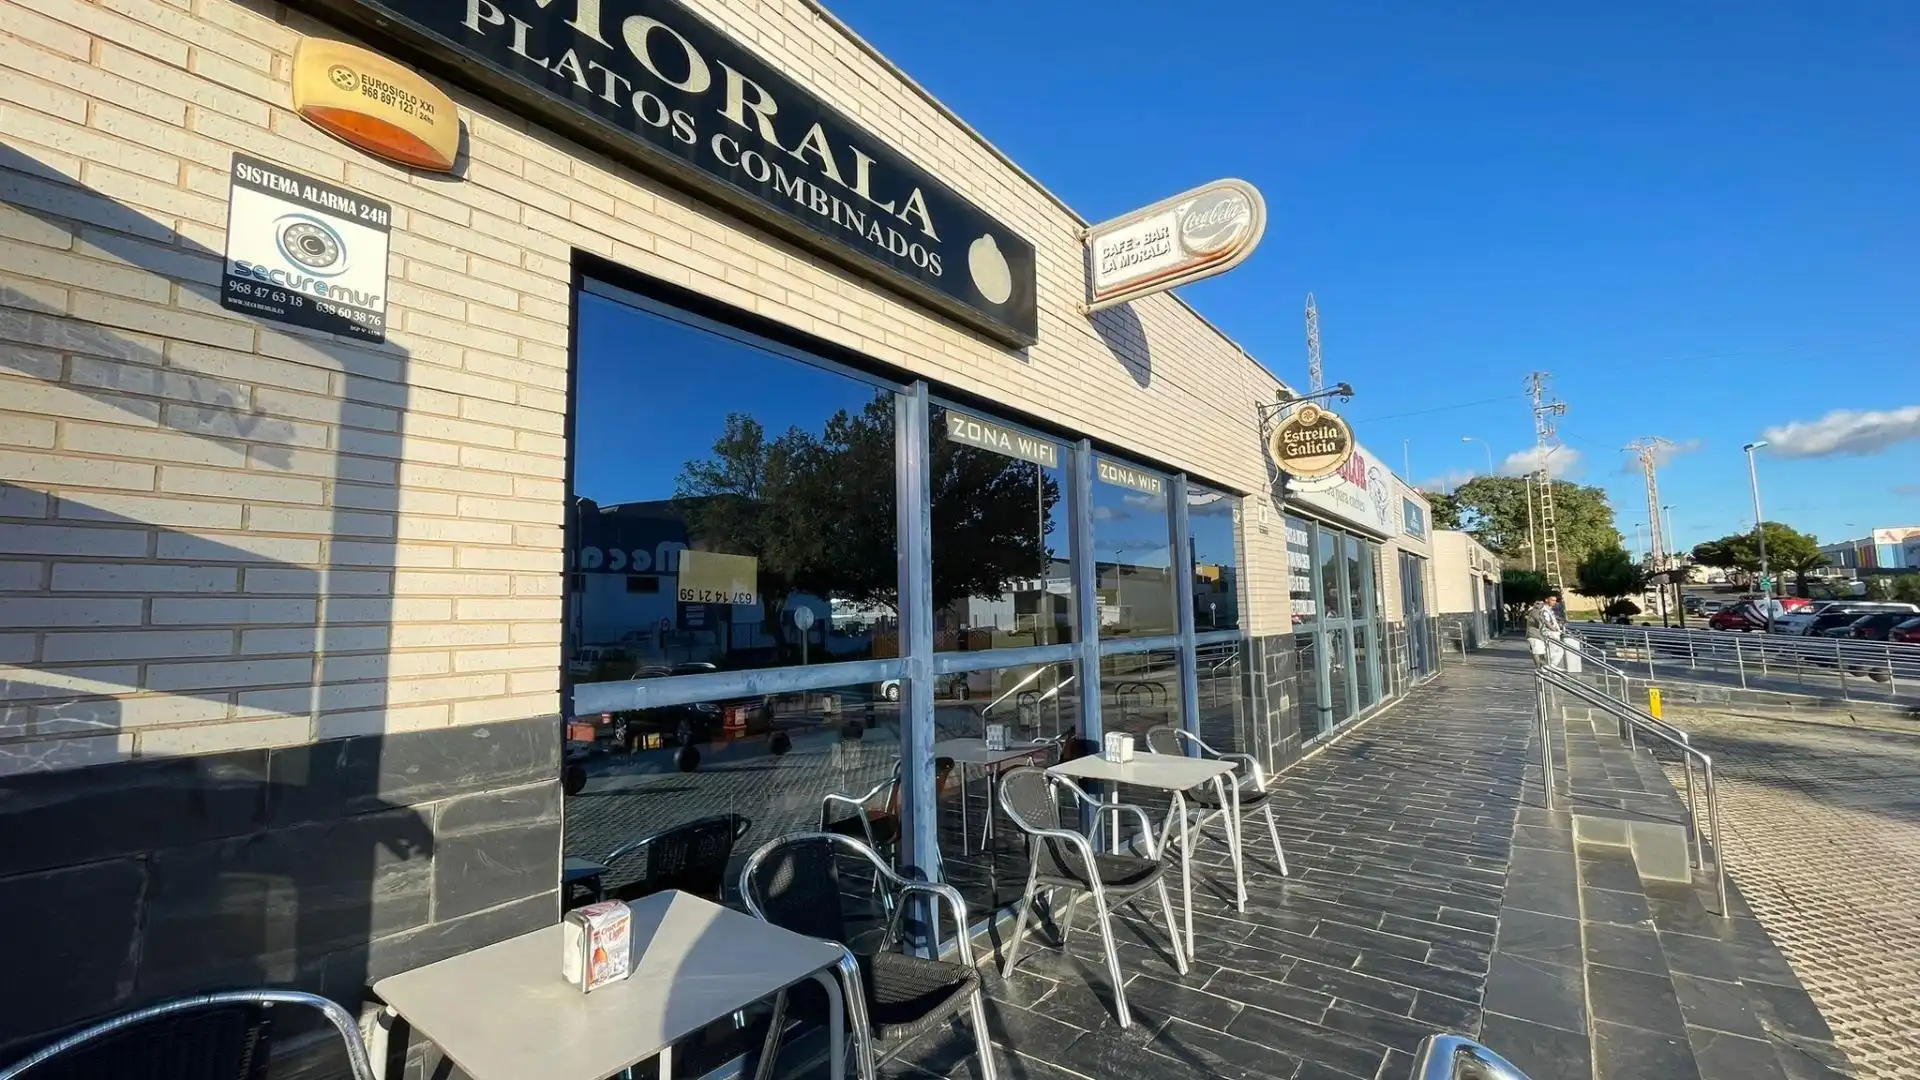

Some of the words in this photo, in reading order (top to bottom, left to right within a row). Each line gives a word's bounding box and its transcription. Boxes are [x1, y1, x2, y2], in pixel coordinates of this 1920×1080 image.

[361, 74, 417, 104] EUROSIGLO
[419, 99, 435, 114] XXI
[361, 84, 379, 100] 968
[380, 91, 397, 107] 897
[398, 99, 414, 115] 123
[460, 0, 698, 145] PLATOS
[710, 132, 944, 277] COMBINADOS
[236, 162, 300, 198] SISTEMA
[302, 184, 357, 216] ALARMA
[360, 203, 388, 226] 24H
[1101, 260, 1117, 275] LA
[1120, 240, 1171, 268] MORALA
[1103, 238, 1134, 259] CAFE
[1143, 226, 1170, 245] BAR
[229, 280, 252, 295] 968
[253, 286, 270, 299] 47
[272, 291, 287, 304] 63
[289, 295, 303, 308] 18
[233, 259, 381, 309] securemur
[316, 301, 336, 316] 638
[337, 306, 351, 320] 60
[353, 310, 367, 323] 38
[368, 314, 382, 327] 76
[952, 416, 1012, 451] ZONA
[1018, 436, 1054, 464] WIFI
[1283, 426, 1338, 444] Estrella
[1286, 440, 1336, 457] Galicia
[1100, 464, 1134, 485] ZONA
[1139, 475, 1161, 494] WIFI
[680, 588, 694, 601] 59
[699, 590, 712, 602] 21
[715, 591, 728, 602] 14
[733, 592, 752, 604] 637
